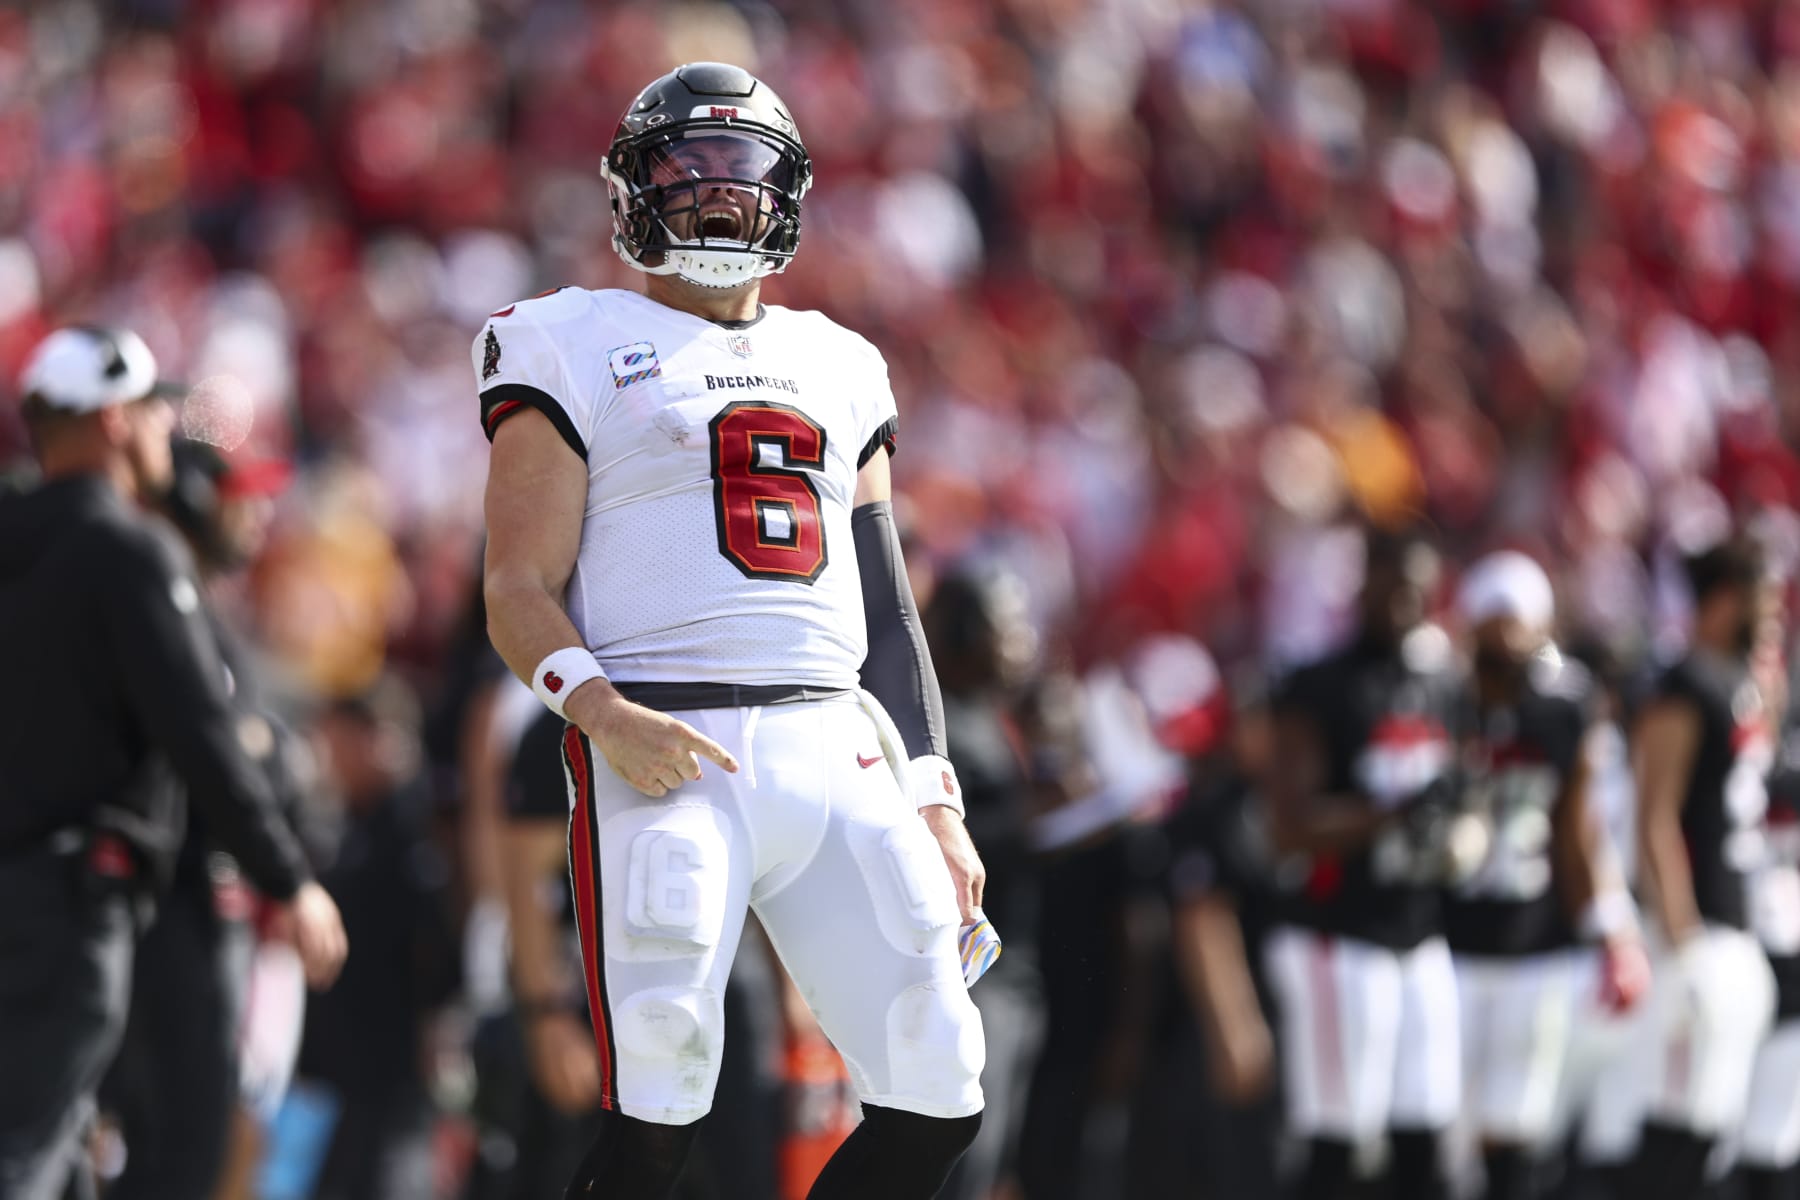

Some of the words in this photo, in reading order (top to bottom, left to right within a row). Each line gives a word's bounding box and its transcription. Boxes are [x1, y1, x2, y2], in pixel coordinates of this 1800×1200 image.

[704, 374, 798, 394] BUCCANEERS
[708, 400, 829, 586] 6
[543, 671, 564, 694] 6
[941, 770, 954, 796] 6
